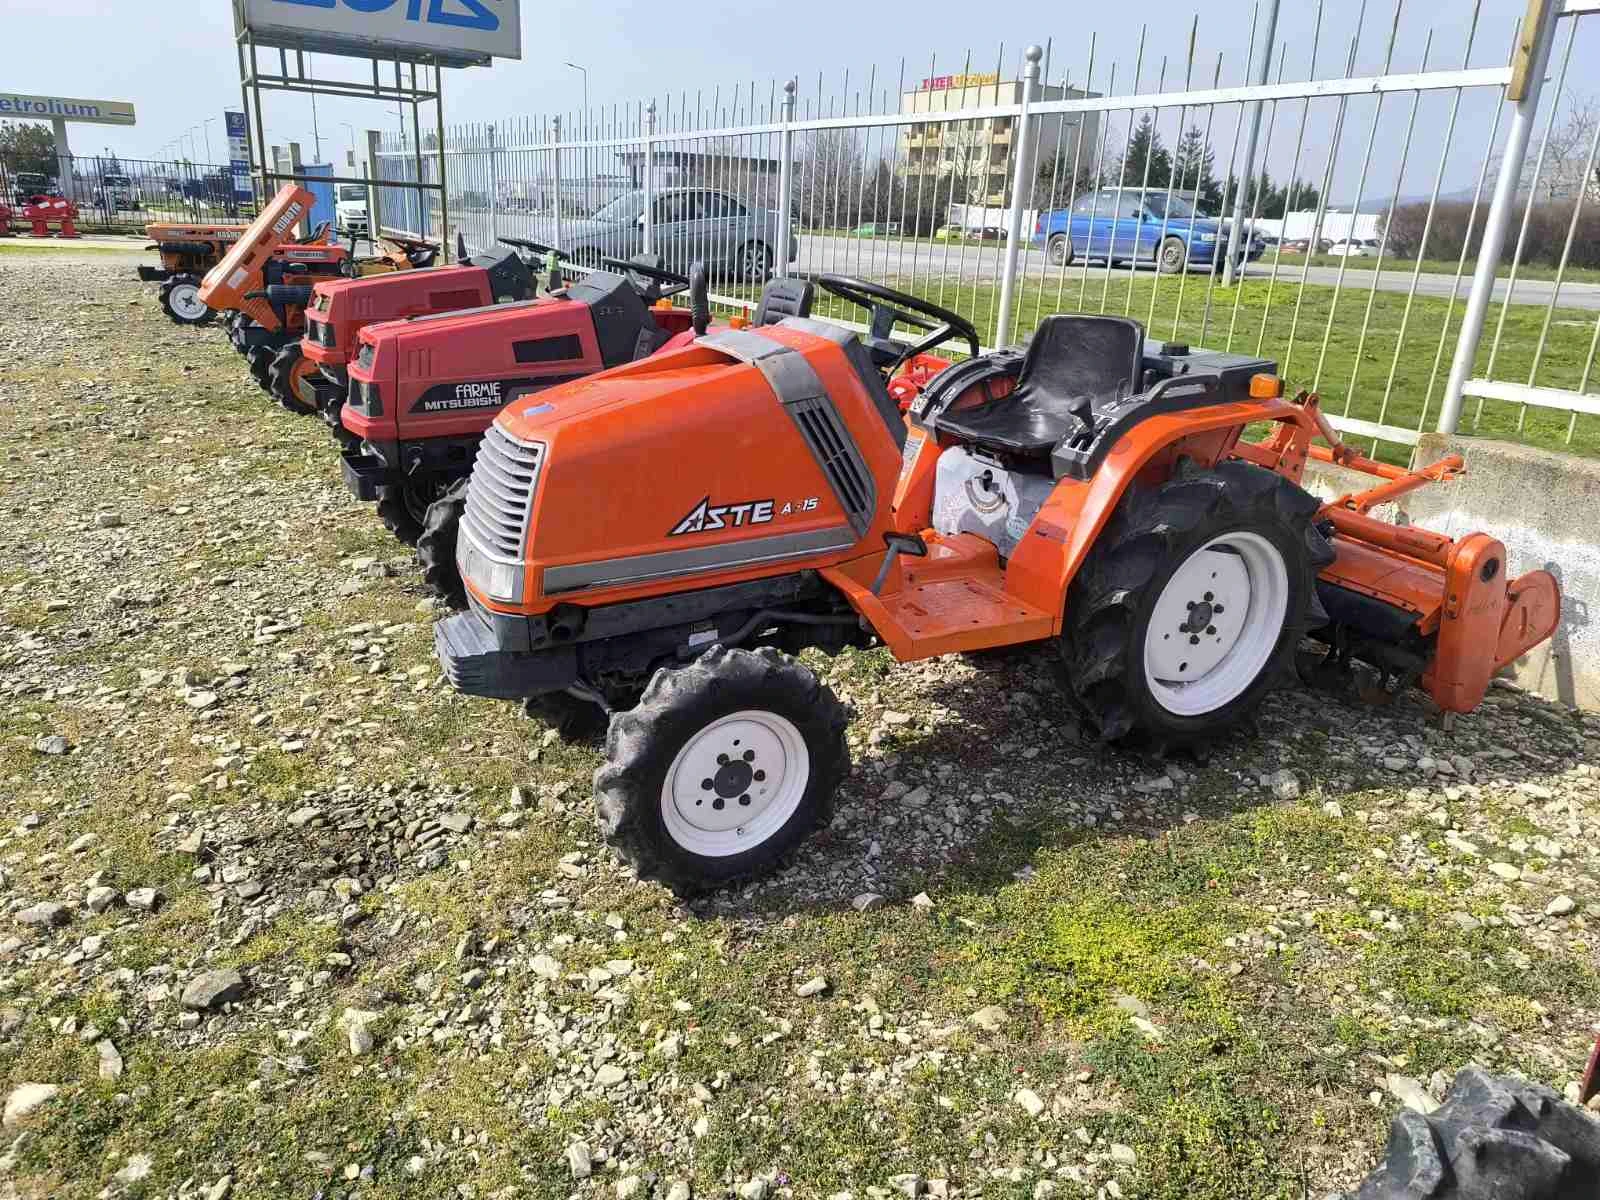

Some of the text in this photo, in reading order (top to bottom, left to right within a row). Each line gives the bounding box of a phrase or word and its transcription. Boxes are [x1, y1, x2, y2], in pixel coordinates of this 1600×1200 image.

[455, 382, 501, 398] FARMIE
[424, 396, 502, 411] MITSUBISHI
[668, 497, 775, 535] ASTE
